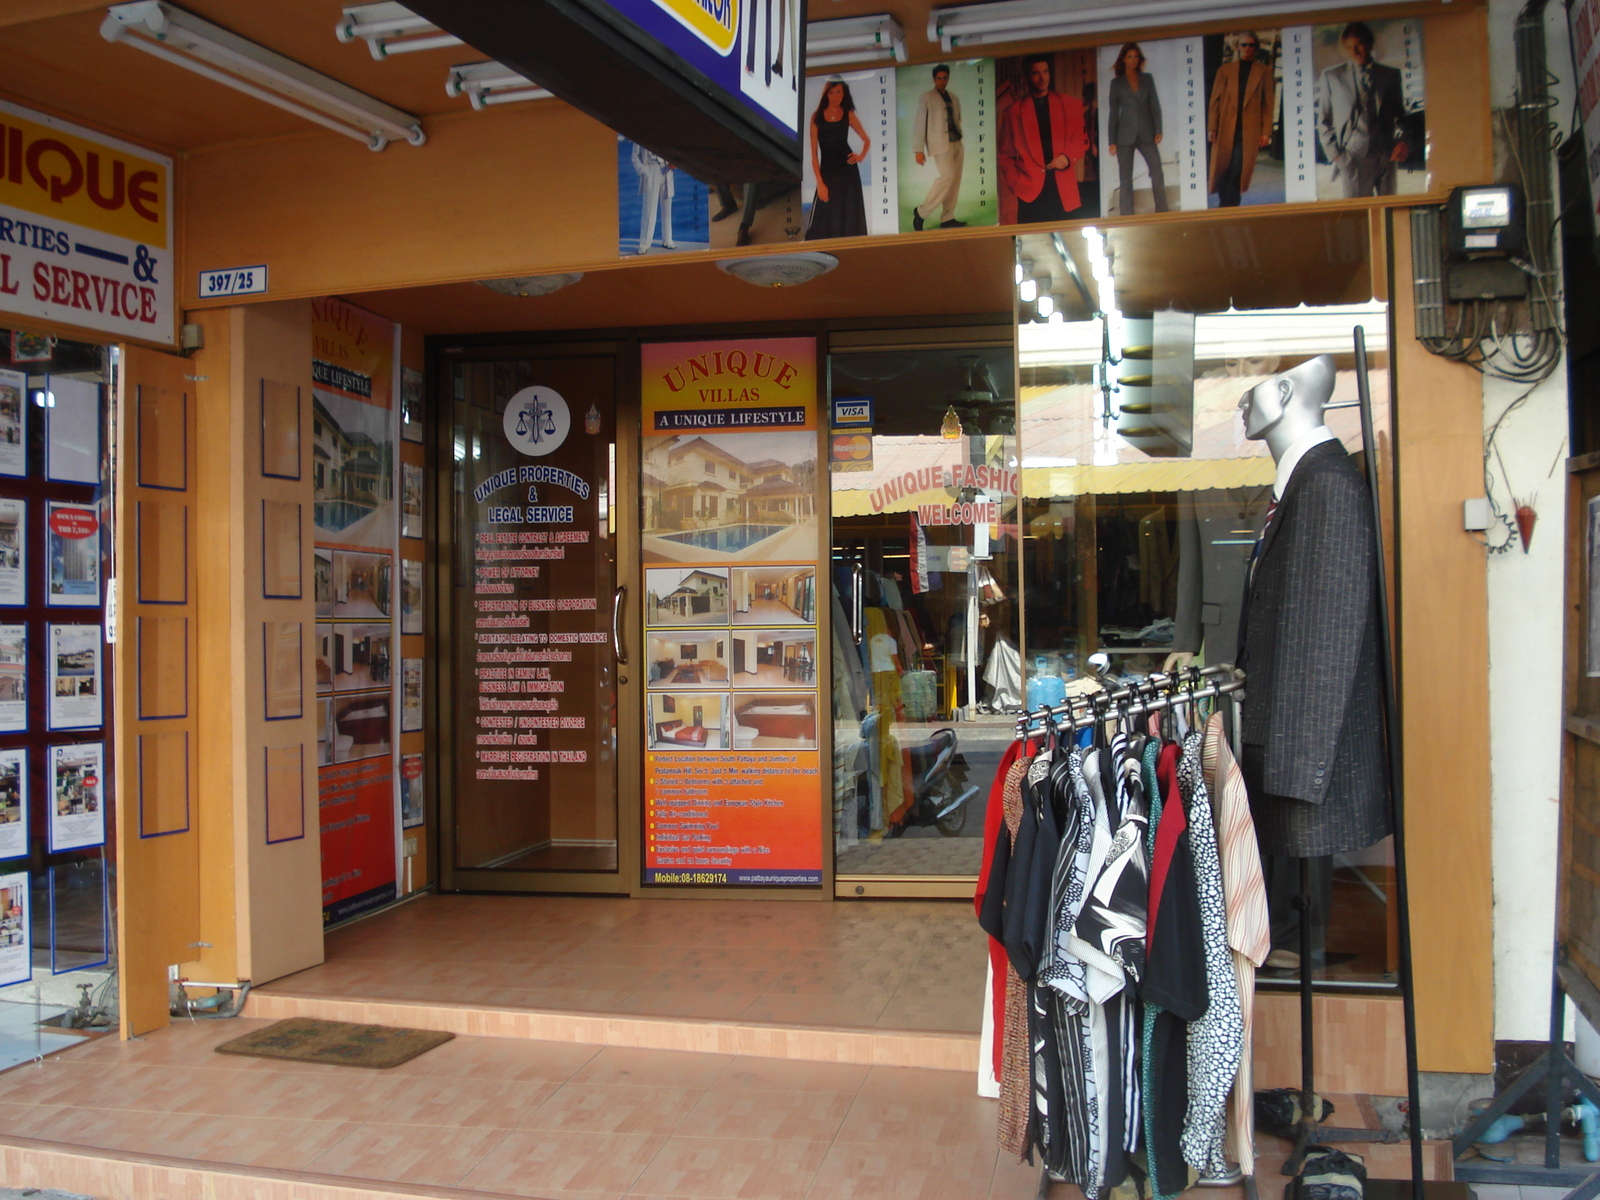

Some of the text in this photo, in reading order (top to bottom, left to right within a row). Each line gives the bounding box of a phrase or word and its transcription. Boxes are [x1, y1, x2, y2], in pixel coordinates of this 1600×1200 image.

[0, 123, 158, 223] IQUE
[133, 244, 158, 284] &
[209, 272, 254, 294] 397/25
[33, 261, 157, 324] SERVICE
[661, 349, 798, 393] UNIQUE
[331, 369, 370, 393] LIFESTYLE
[698, 387, 760, 403] VILLAS
[659, 411, 805, 427] A UNIQUE LIFESTYLE
[841, 408, 864, 416] VISA
[474, 465, 590, 503] UNIQUE PROPERTIES
[869, 464, 944, 513] UNIQUE
[528, 485, 537, 502] &
[488, 506, 574, 524] LEGAL SERVICE
[917, 501, 997, 526] WELCOME
[480, 533, 495, 544] REAL
[495, 532, 518, 544] ESTATE
[518, 532, 548, 543] CONTRACT
[555, 531, 590, 543] AGREEMENT
[480, 566, 540, 578] POWER OF ATTORNEY
[478, 598, 597, 612] REGISTRATION OF BUSINESS CORPORATION
[511, 633, 538, 644] RELATING
[539, 633, 548, 644] TO
[548, 633, 579, 644] DOMESTIC
[579, 632, 608, 643] VIOLENCE
[479, 668, 507, 679] PRACTICE
[507, 668, 515, 679] IN
[515, 668, 536, 679] FAMILY
[479, 681, 565, 693] BUSINESS LAW & IMMIGRATION
[480, 716, 514, 728] CONTESTED
[518, 717, 560, 729] UNCONTESTED
[559, 717, 586, 729] DIVORCE
[480, 751, 587, 763] MARRIAGE REGISTRATION IN THAILAND
[737, 755, 756, 764] Pattaya
[741, 767, 760, 776] walking
[654, 873, 727, 884] Mobile:08-18629174
